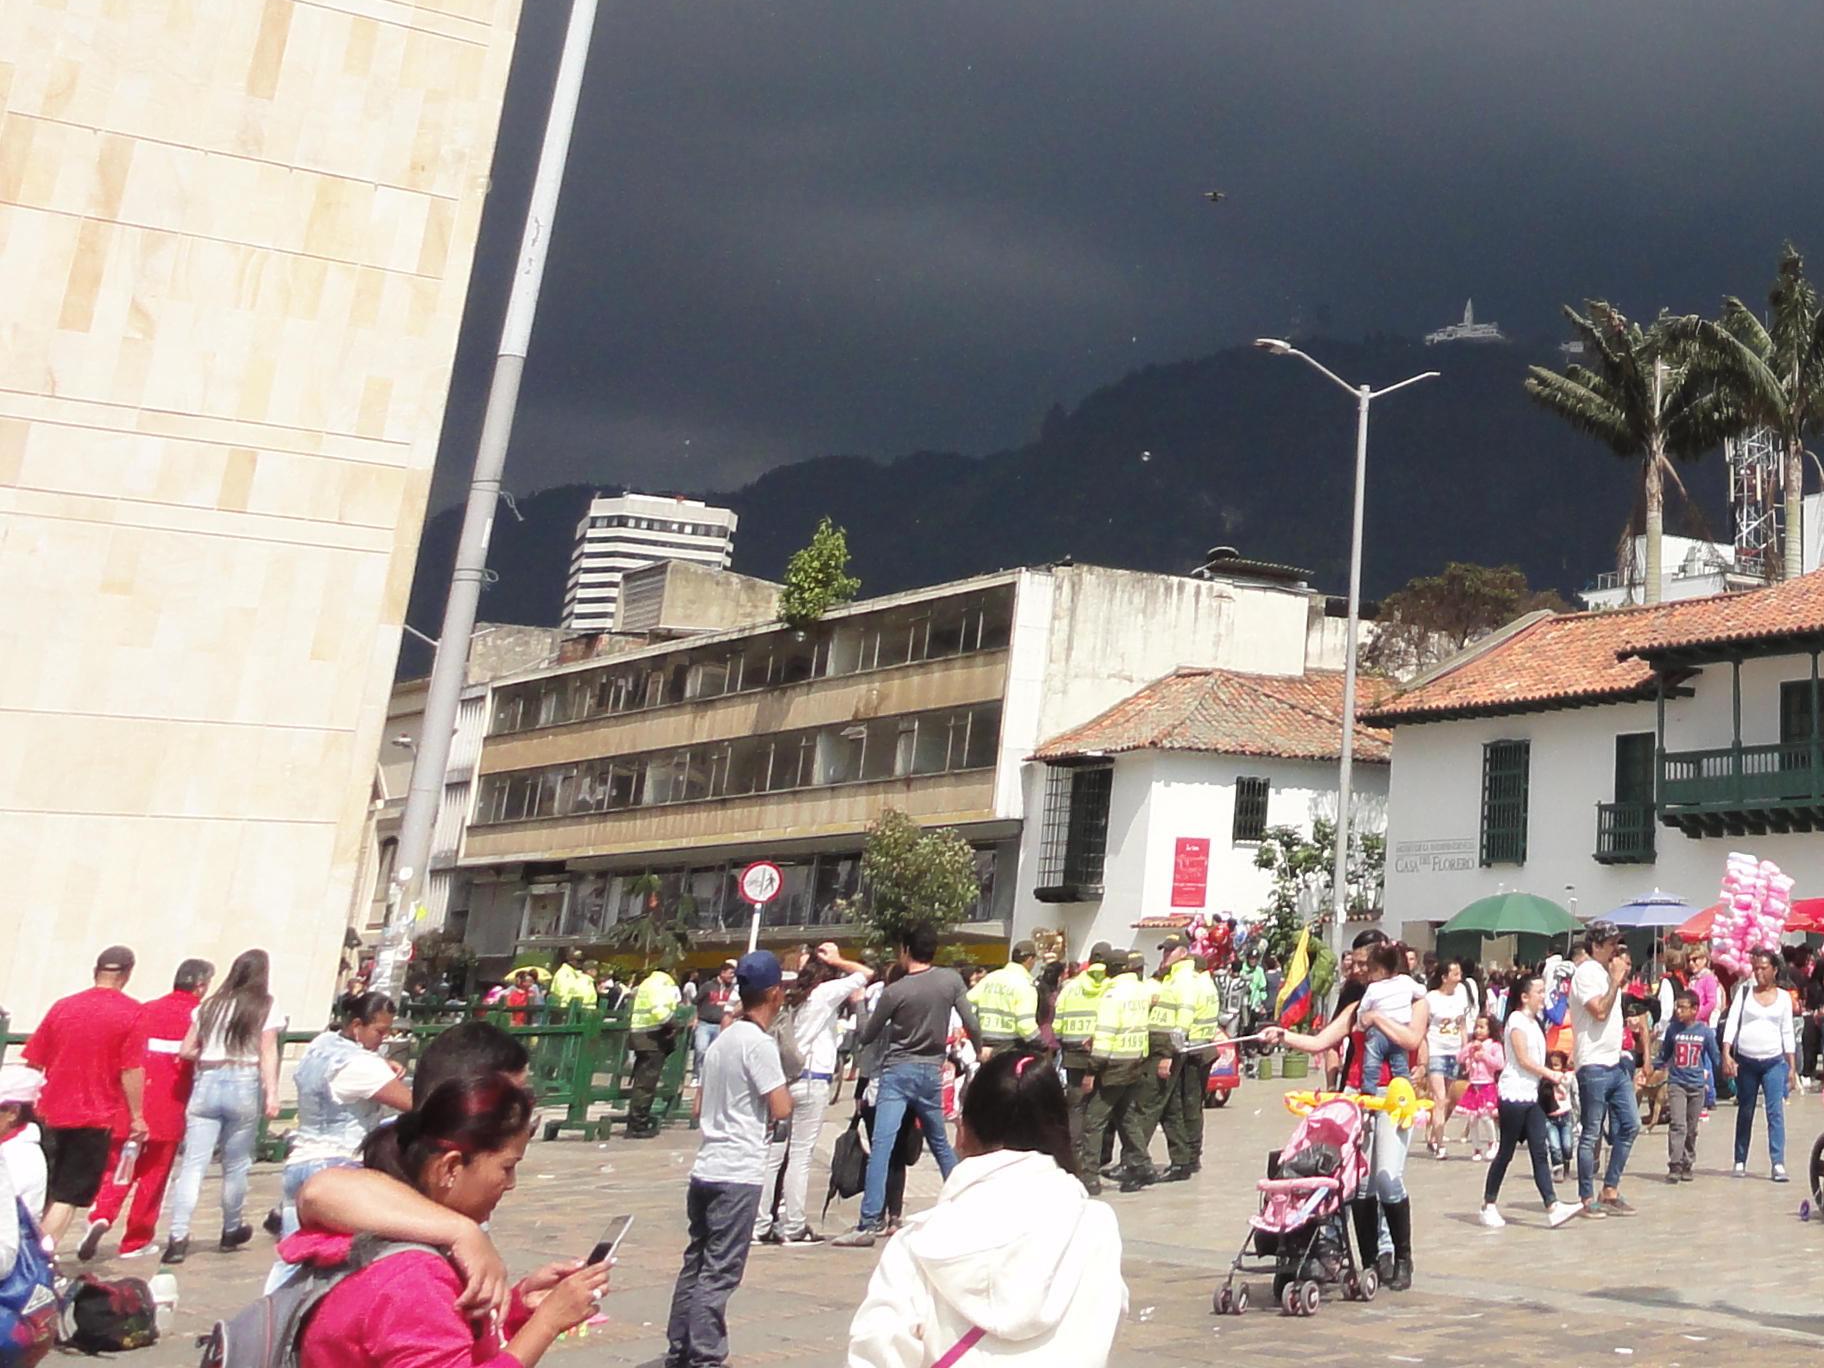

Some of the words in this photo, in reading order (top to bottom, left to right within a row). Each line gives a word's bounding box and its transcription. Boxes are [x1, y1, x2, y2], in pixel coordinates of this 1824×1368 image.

[1432, 855, 1475, 871] FLORERO
[1063, 1018, 1097, 1032] 1837
[1675, 1041, 1704, 1068] 87
